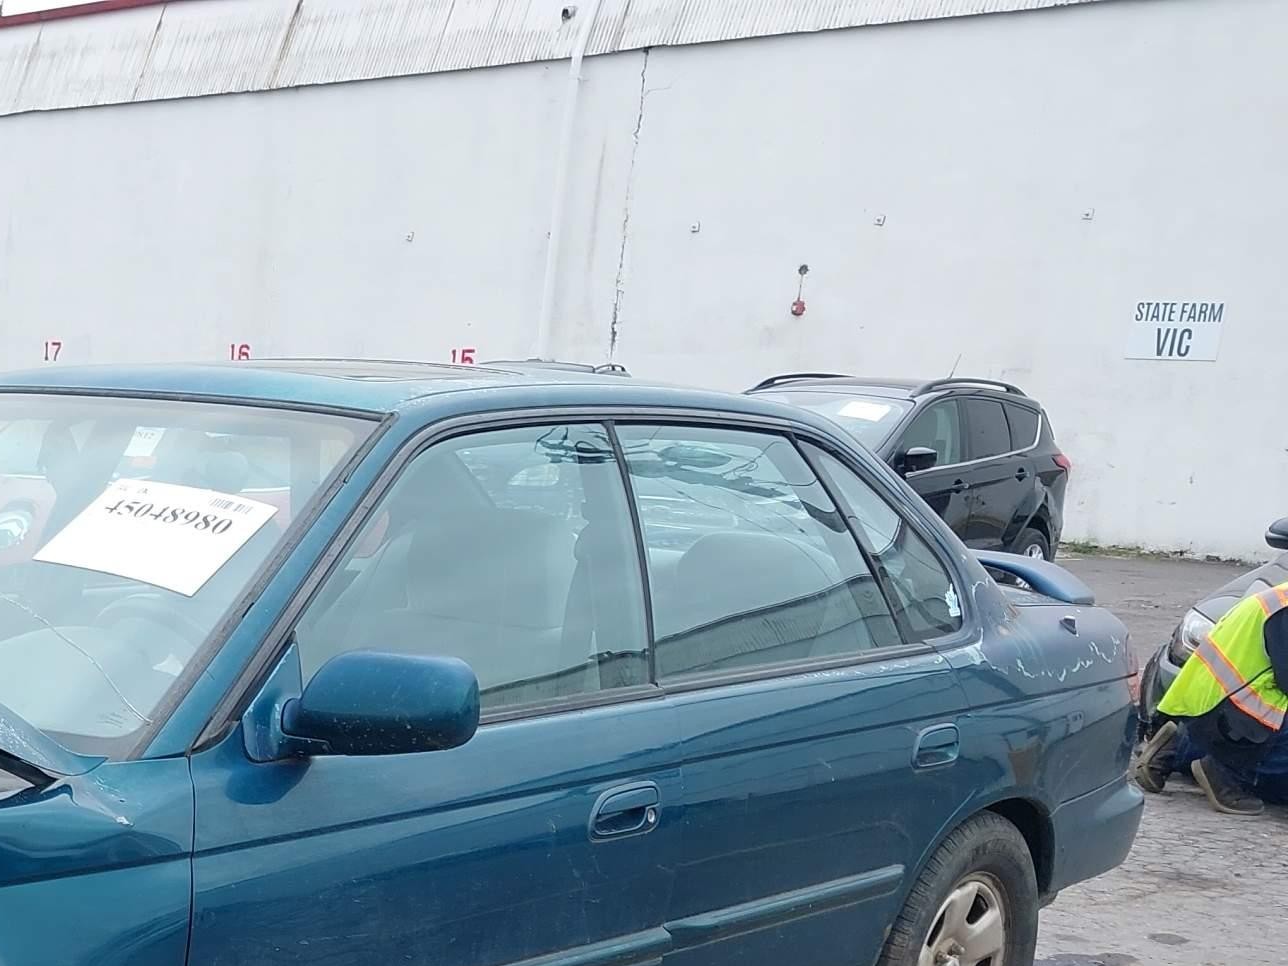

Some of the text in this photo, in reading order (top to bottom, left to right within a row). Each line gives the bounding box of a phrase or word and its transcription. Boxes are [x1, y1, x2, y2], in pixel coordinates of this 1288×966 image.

[1135, 302, 1224, 322] STATE FARM
[44, 341, 62, 361] 17
[231, 344, 250, 360] 16
[1156, 328, 1192, 357] VIC
[452, 349, 475, 364] 15
[105, 499, 233, 534] 45048980
